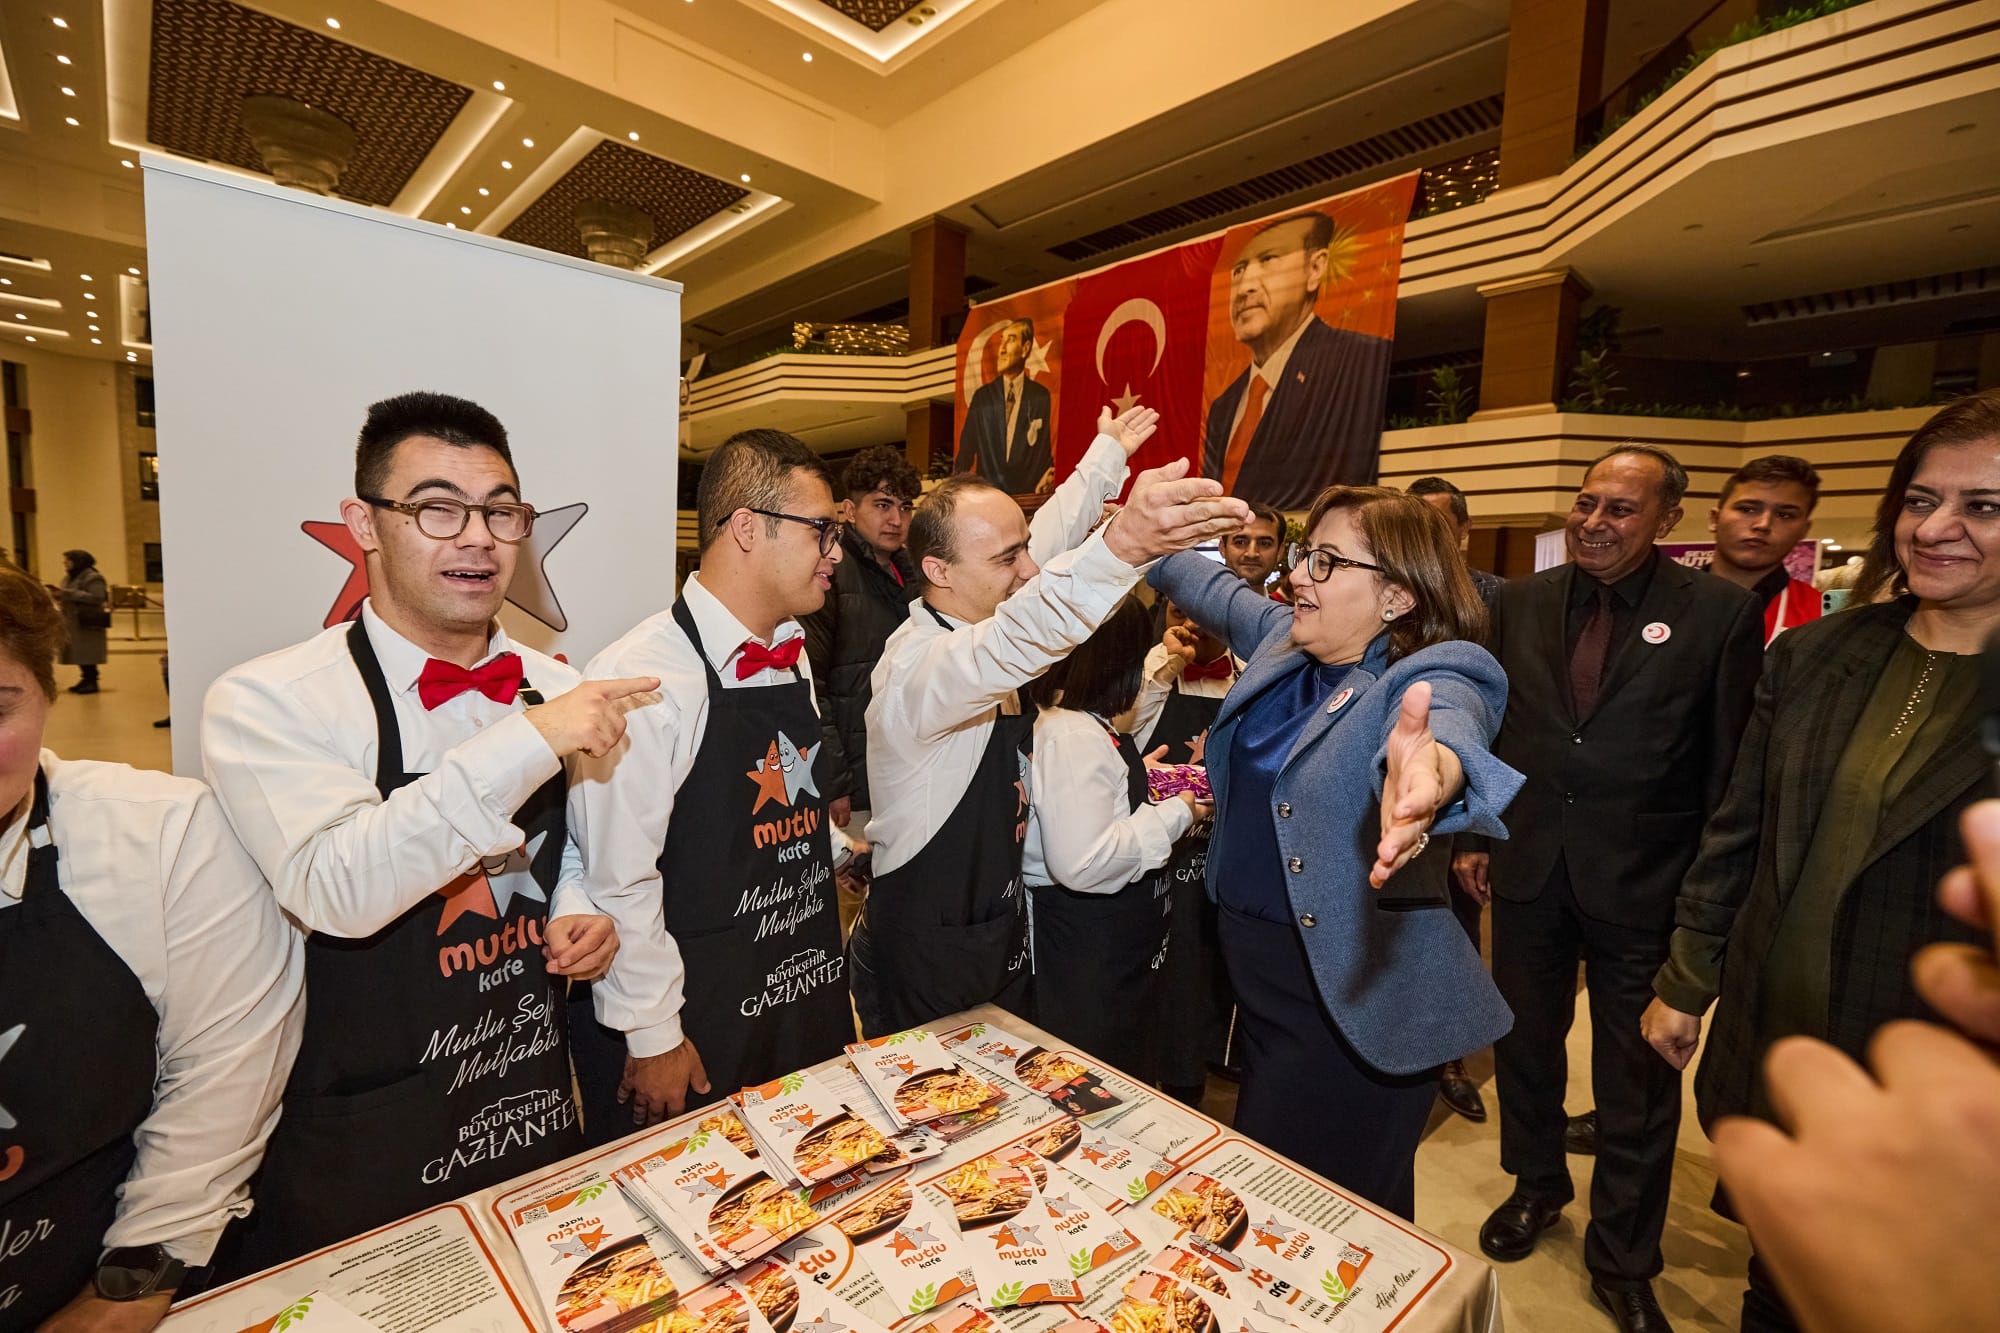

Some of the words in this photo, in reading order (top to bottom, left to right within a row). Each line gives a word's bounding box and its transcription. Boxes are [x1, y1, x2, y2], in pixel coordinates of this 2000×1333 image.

[753, 807, 821, 849] mutlu
[778, 841, 811, 863] kafe
[733, 877, 795, 917] Mutlu
[797, 860, 831, 900] Şefler
[754, 893, 824, 942] Mutfakta
[439, 915, 548, 978] mutlu
[478, 959, 525, 993] kafe
[766, 949, 828, 987] BÜYÜKŞEHİR
[740, 956, 844, 1017] GAZİANTEP
[419, 1009, 505, 1064] Mutlu
[512, 986, 553, 1033] Şef
[447, 1023, 559, 1095] Mutfakta
[874, 1054, 911, 1067] mutlu
[458, 1088, 562, 1143] BÜYÜKŞEHİR
[768, 1103, 809, 1123] mutlu
[775, 1103, 795, 1113] kafe
[681, 1162, 703, 1174] kafe
[1100, 1149, 1131, 1171] mutlu
[1117, 1159, 1132, 1170] kafe
[674, 1161, 719, 1186] mutlu
[546, 1216, 601, 1242] mutlu
[558, 1216, 584, 1229] kafe
[1067, 1223, 1088, 1236] kafe
[0, 1217, 55, 1262] ler
[1282, 1231, 1311, 1262] mutlu
[798, 1249, 837, 1274] tlu
[900, 1243, 947, 1267] mutlu
[919, 1256, 942, 1270] kafe
[998, 1247, 1047, 1261] mutlu
[1014, 1258, 1038, 1266] kafe
[1299, 1245, 1315, 1260] kafe
[813, 1271, 831, 1285] fe
[1268, 1280, 1290, 1299] afe
[1376, 1284, 1399, 1310] Afiyet
